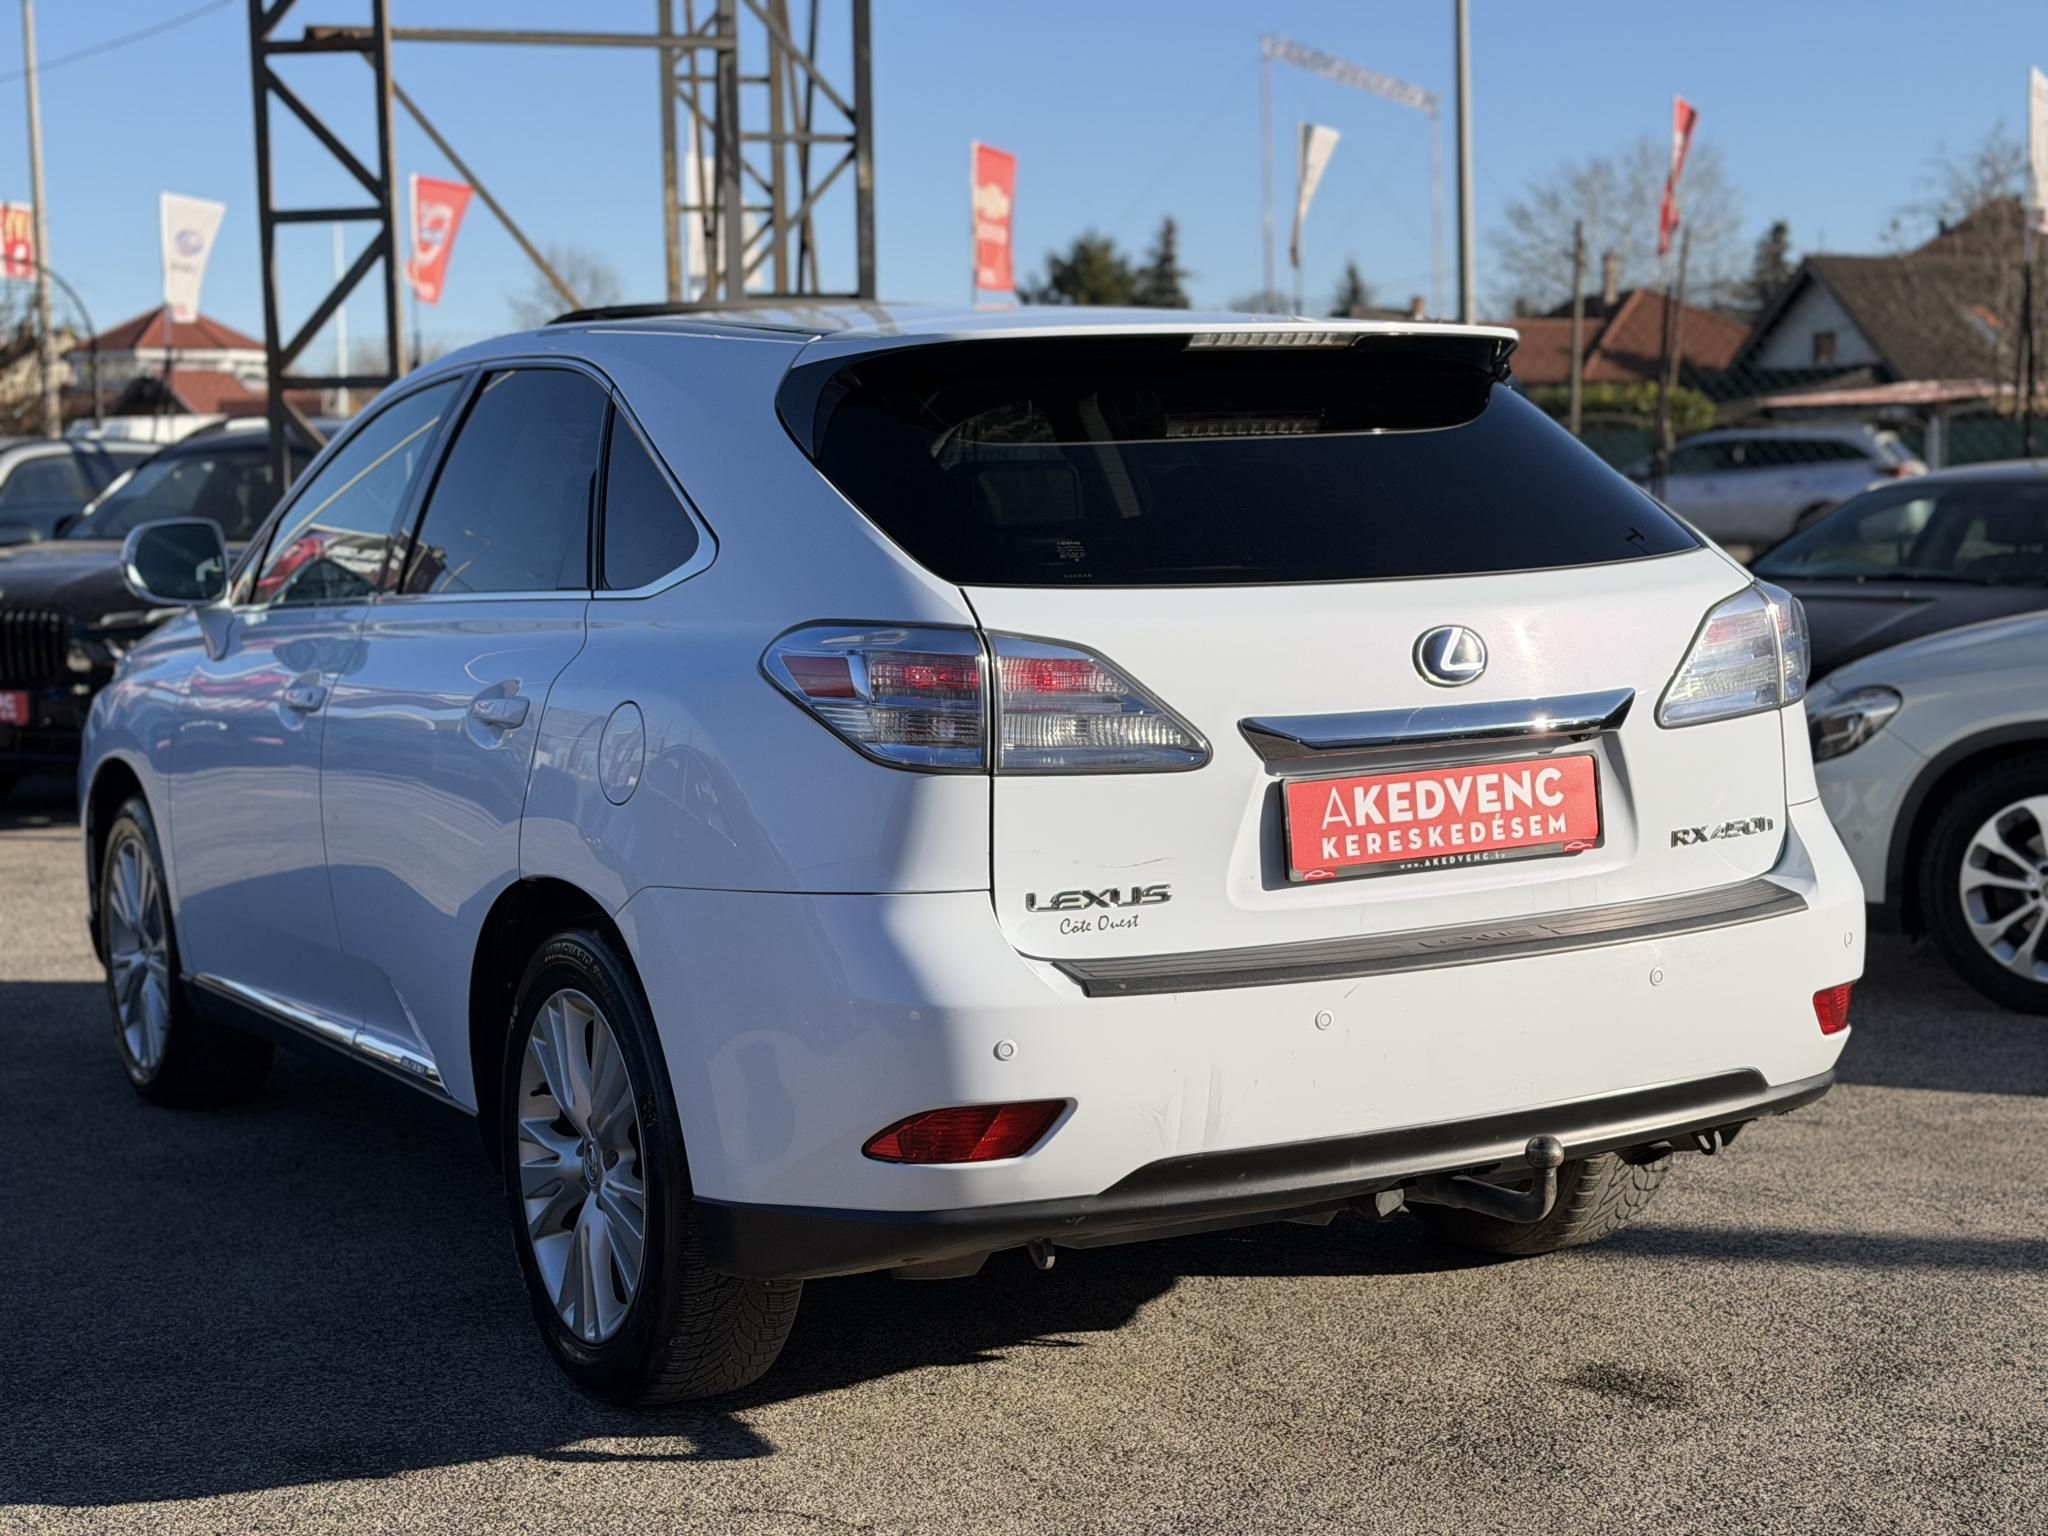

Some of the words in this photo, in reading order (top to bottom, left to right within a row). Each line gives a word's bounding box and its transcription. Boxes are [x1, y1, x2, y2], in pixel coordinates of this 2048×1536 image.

[1321, 813, 1567, 860] KERESKEDÉSEM
[1025, 883, 1173, 912] LEXUS
[1060, 917, 1092, 935] Côte
[1098, 914, 1139, 931] Ouest
